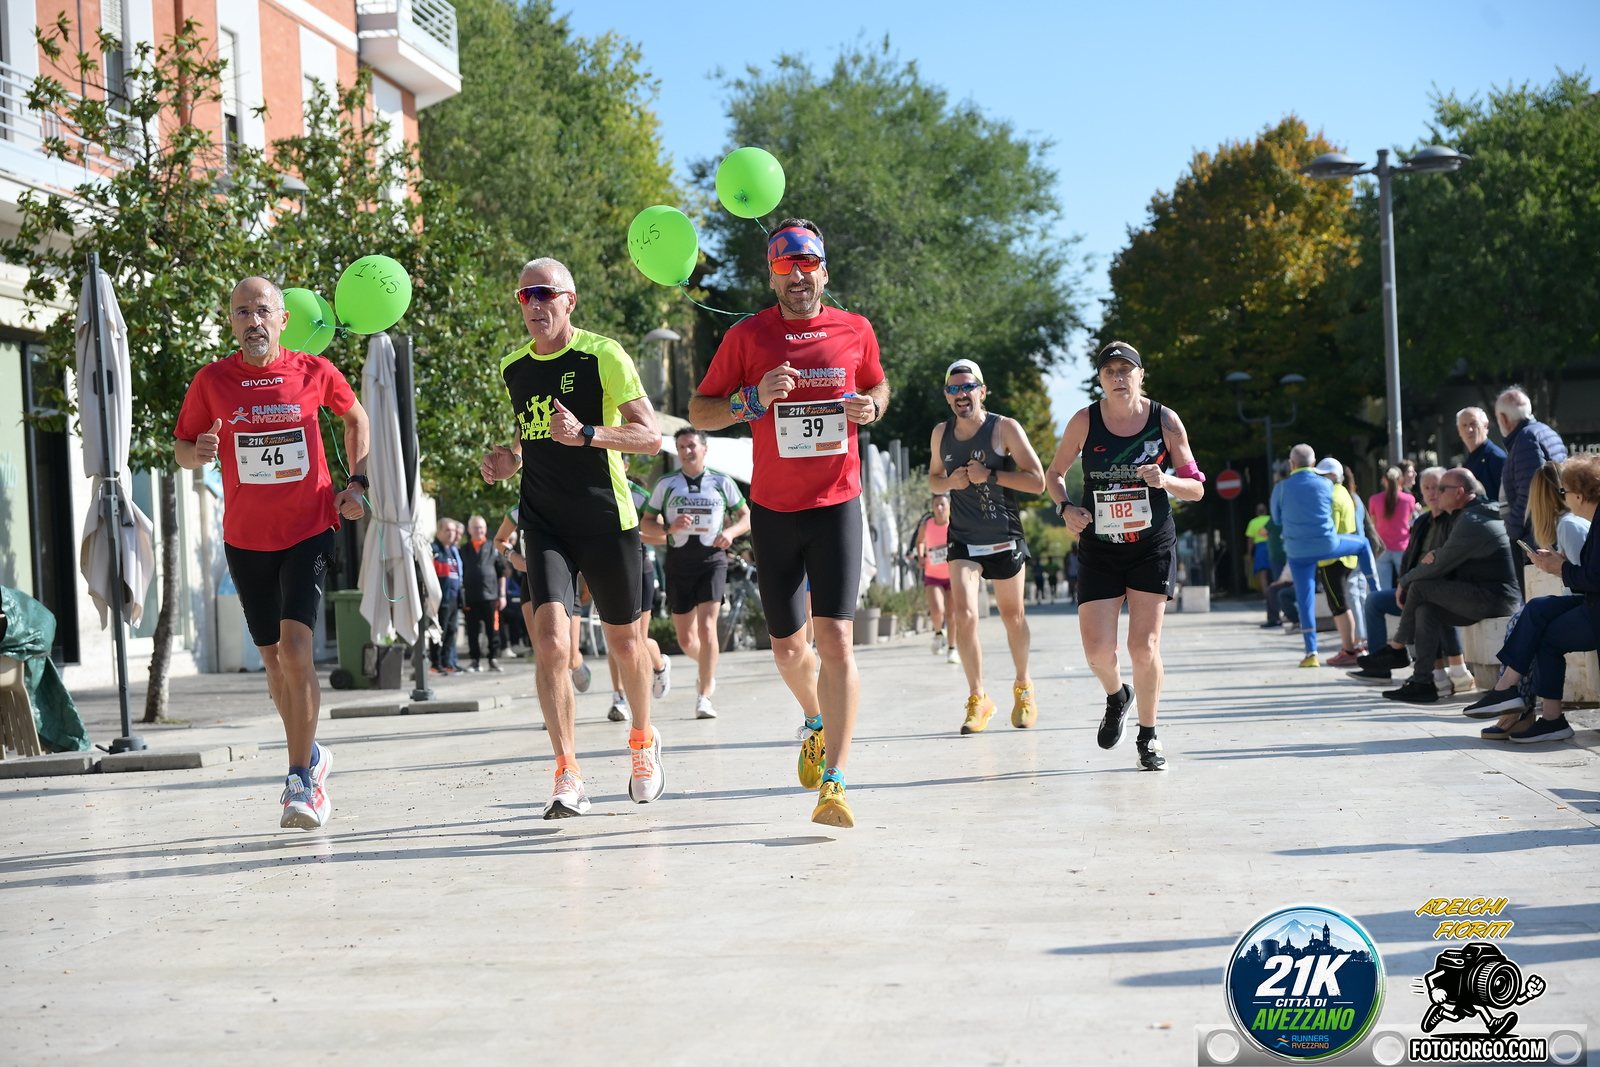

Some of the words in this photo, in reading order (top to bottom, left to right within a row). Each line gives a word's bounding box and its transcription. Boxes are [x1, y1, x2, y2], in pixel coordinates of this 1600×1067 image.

[784, 331, 828, 340] GIVOVA
[797, 367, 847, 379] RUNNERS
[241, 377, 284, 387] GIVOVA
[797, 377, 847, 388] AVEZZANO
[251, 403, 302, 415] RUNNERS
[788, 407, 806, 416] 21K
[251, 413, 302, 424] AVEZZANO
[802, 417, 824, 438] 39
[521, 429, 551, 440] AVEZZ
[248, 437, 264, 446] 21K
[261, 447, 284, 466] 46
[1089, 471, 1138, 479] FROSIN
[1104, 494, 1116, 502] 10K
[1110, 502, 1132, 519] 182
